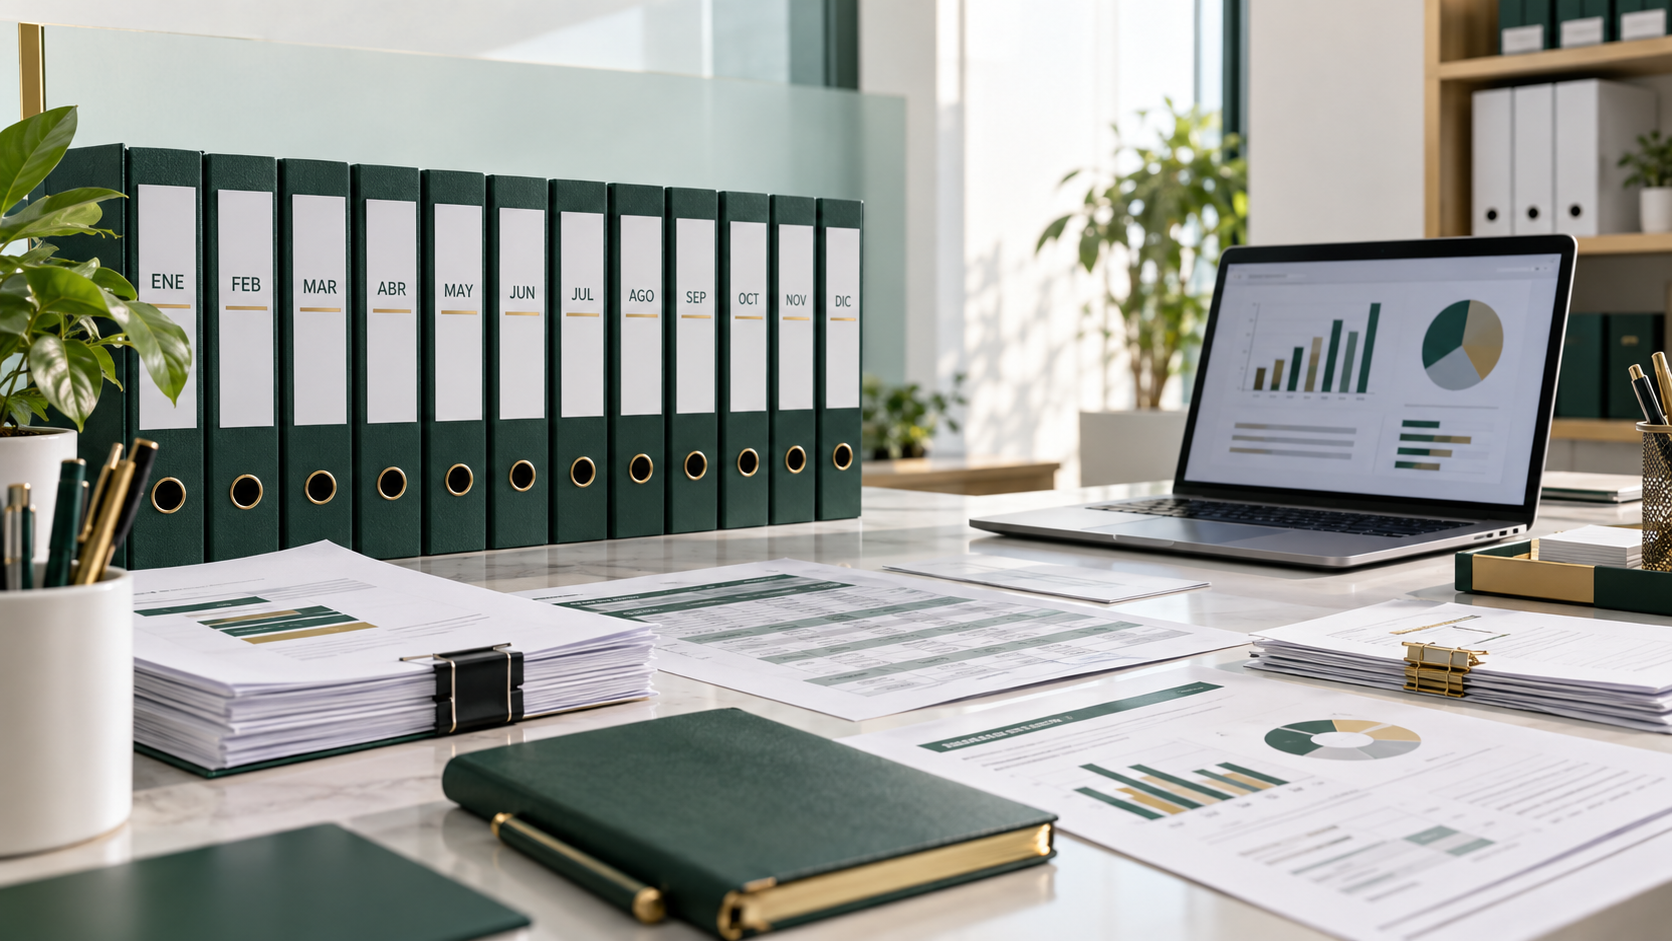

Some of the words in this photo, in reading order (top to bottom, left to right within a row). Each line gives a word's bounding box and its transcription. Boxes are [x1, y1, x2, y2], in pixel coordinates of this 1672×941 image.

[151, 273, 185, 290] ENE
[231, 276, 261, 292] FEB
[303, 279, 337, 295] MAR
[377, 281, 407, 296] ABR
[444, 283, 474, 298] MAY
[509, 285, 536, 300] JUN
[571, 287, 594, 301] JUL
[629, 289, 654, 302] AGO
[686, 291, 707, 304] SEP
[738, 292, 759, 305] OCT
[786, 294, 807, 307] NOV
[835, 295, 852, 307] DIC
